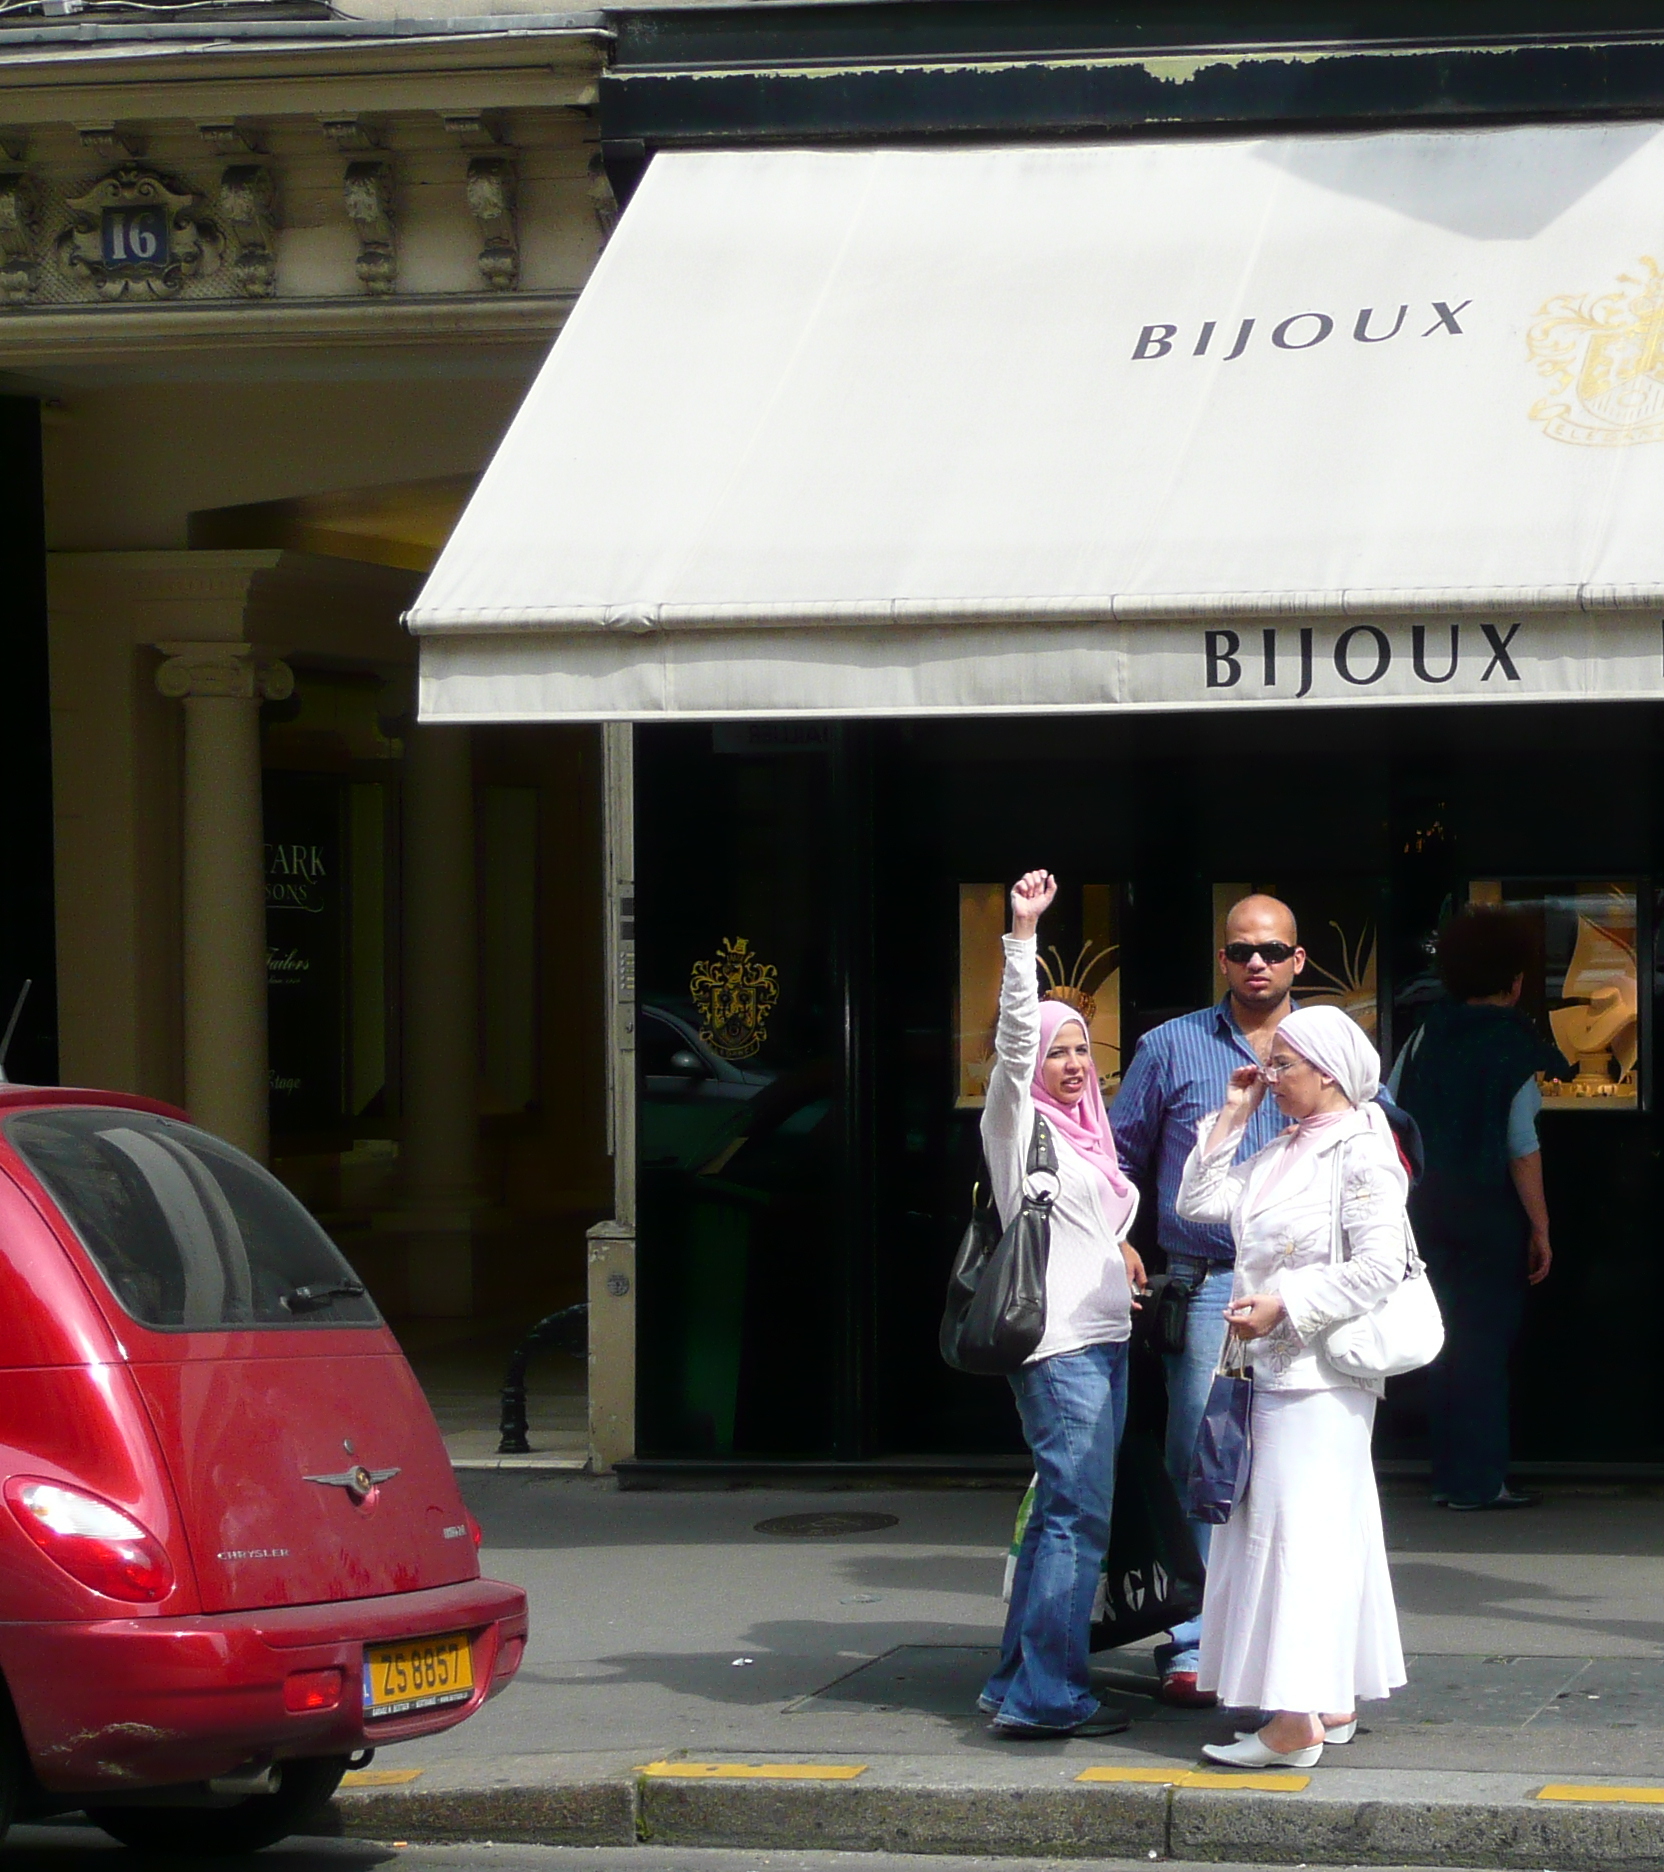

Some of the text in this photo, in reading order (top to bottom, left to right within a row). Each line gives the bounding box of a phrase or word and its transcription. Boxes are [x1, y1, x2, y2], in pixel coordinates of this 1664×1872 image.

[112, 212, 156, 259] 16
[1132, 300, 1471, 361] BIJOUX
[1204, 623, 1522, 699] BIJOUX
[217, 1549, 289, 1560] CHRYSLER
